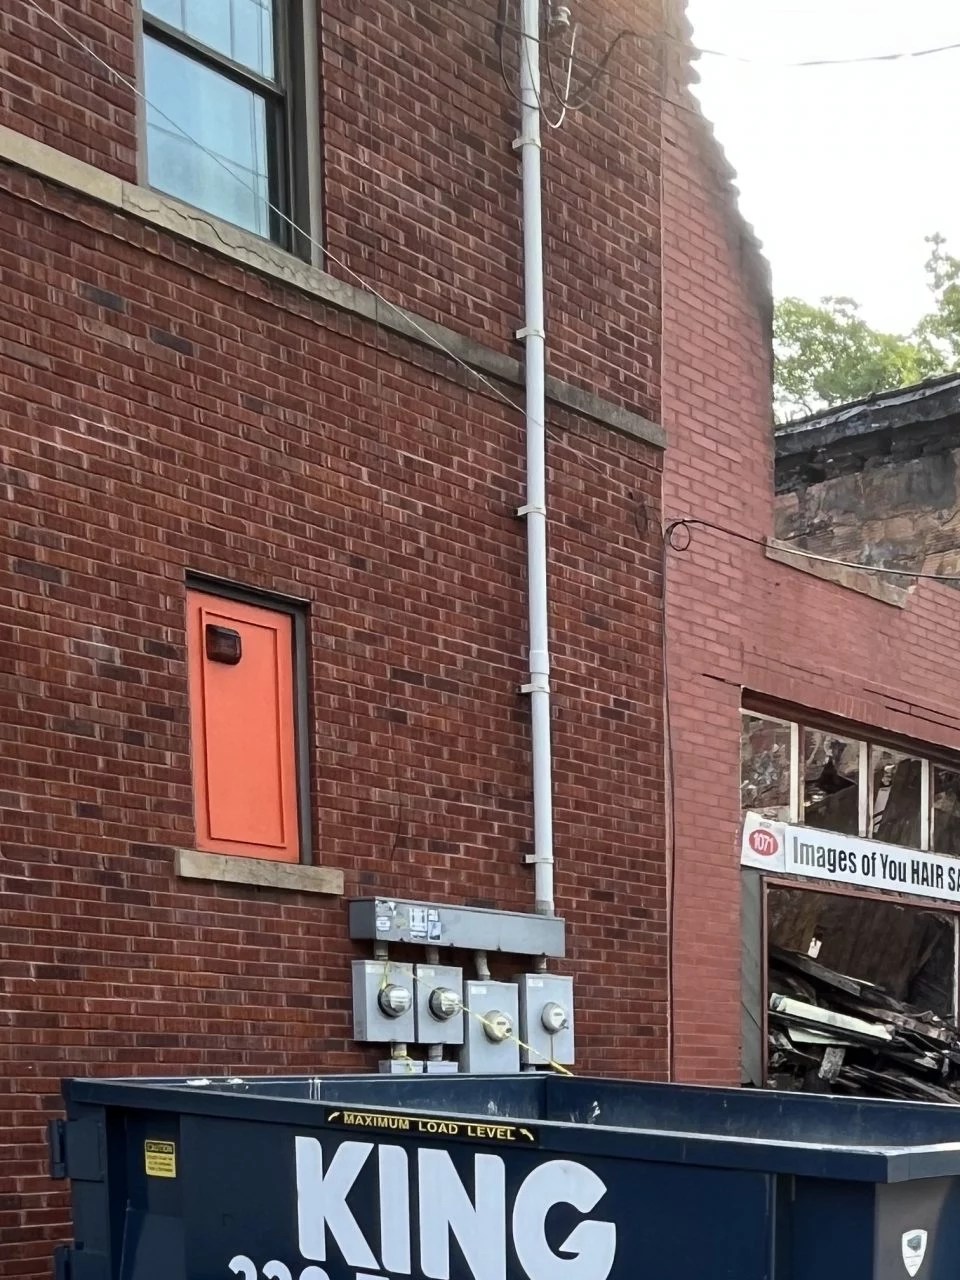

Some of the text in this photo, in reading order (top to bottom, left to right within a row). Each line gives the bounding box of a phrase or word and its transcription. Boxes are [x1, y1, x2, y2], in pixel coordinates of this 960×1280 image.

[753, 832, 774, 854] 1071
[793, 836, 857, 874] Images
[861, 851, 876, 877] of
[880, 853, 907, 883] You
[911, 859, 944, 889] HAIR
[343, 1113, 517, 1141] MAXIMUM LOAD LEVEL
